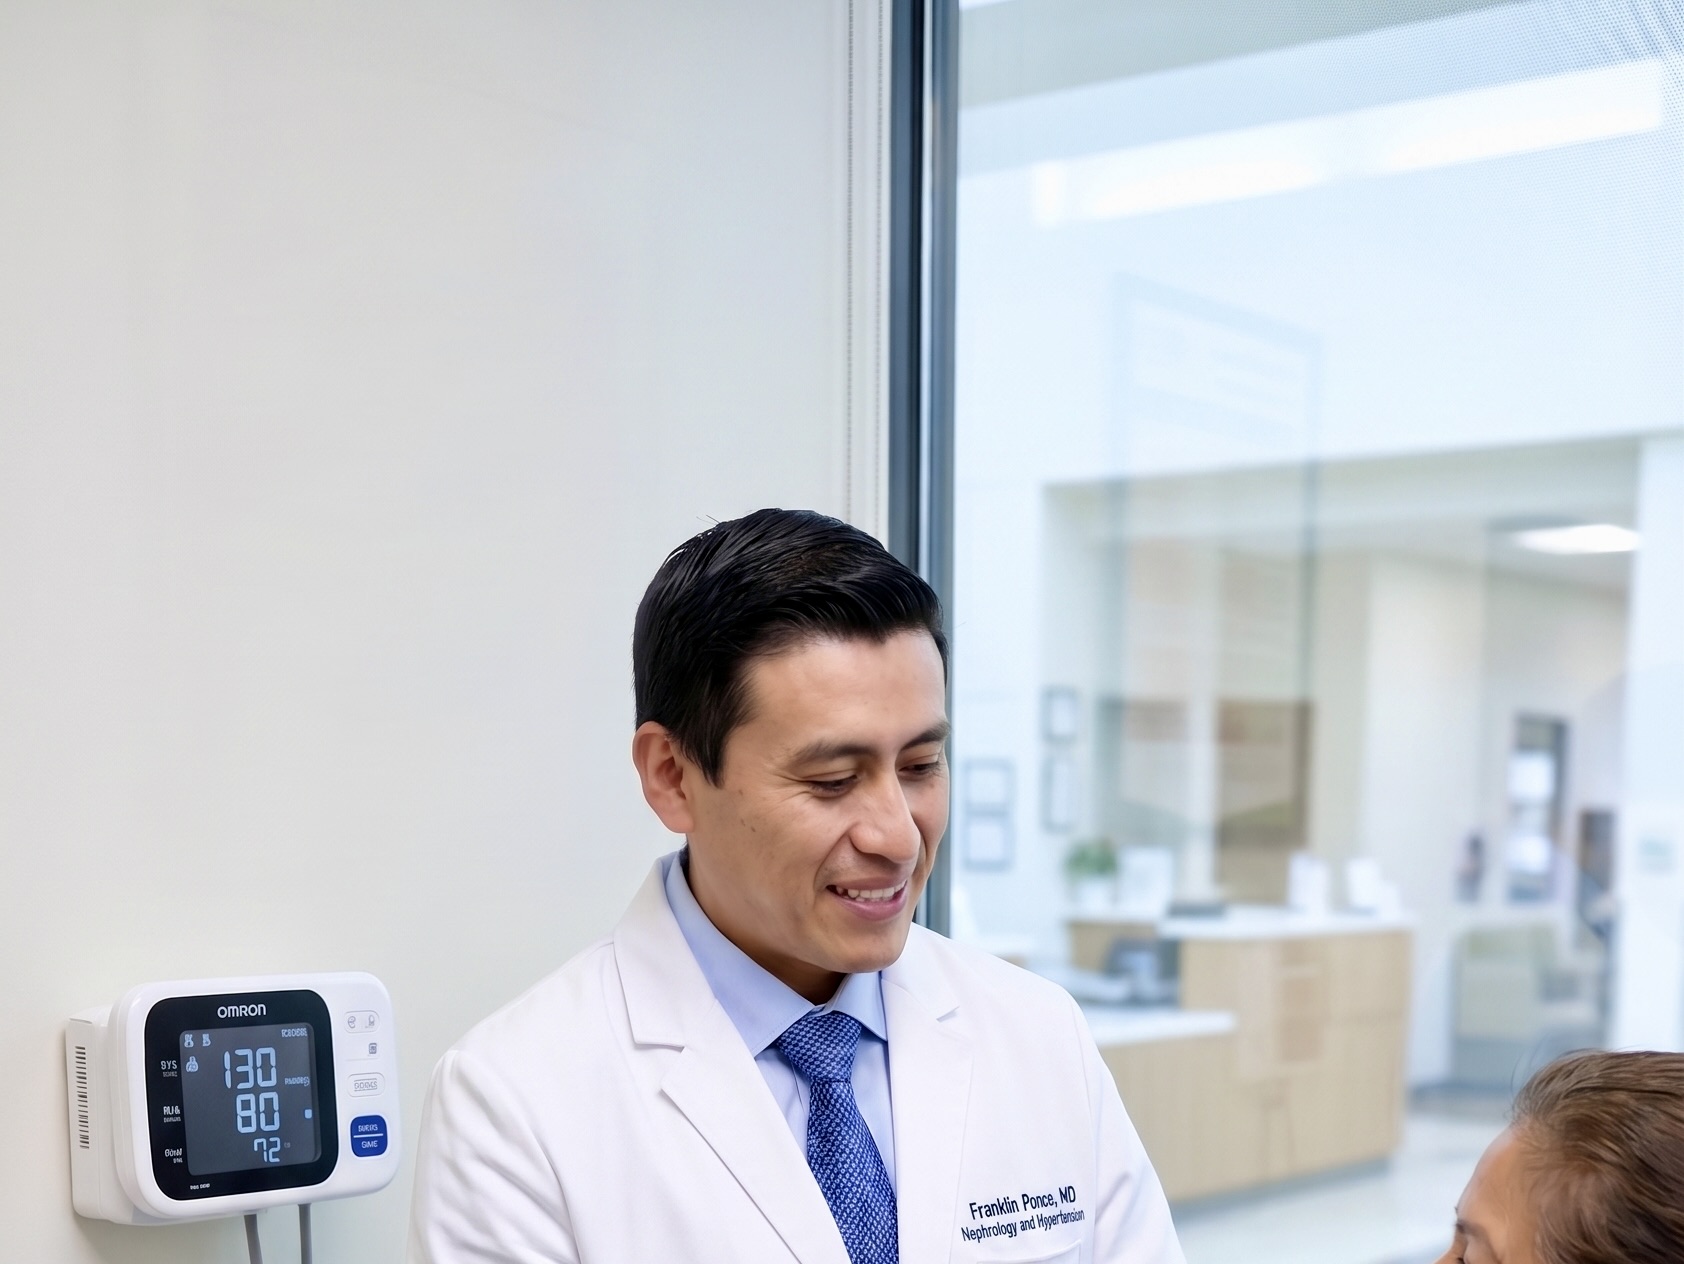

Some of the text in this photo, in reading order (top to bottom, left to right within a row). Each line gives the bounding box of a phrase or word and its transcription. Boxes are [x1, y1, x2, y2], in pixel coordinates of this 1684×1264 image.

[217, 1003, 267, 1019] OMRON
[223, 1047, 277, 1089] 130
[236, 1092, 280, 1134] 80
[253, 1136, 281, 1163] 72
[969, 1196, 1020, 1220] Franklin
[1021, 1193, 1058, 1212] Ponce,
[961, 1221, 1018, 1243] Nephrology
[1020, 1216, 1036, 1231] and
